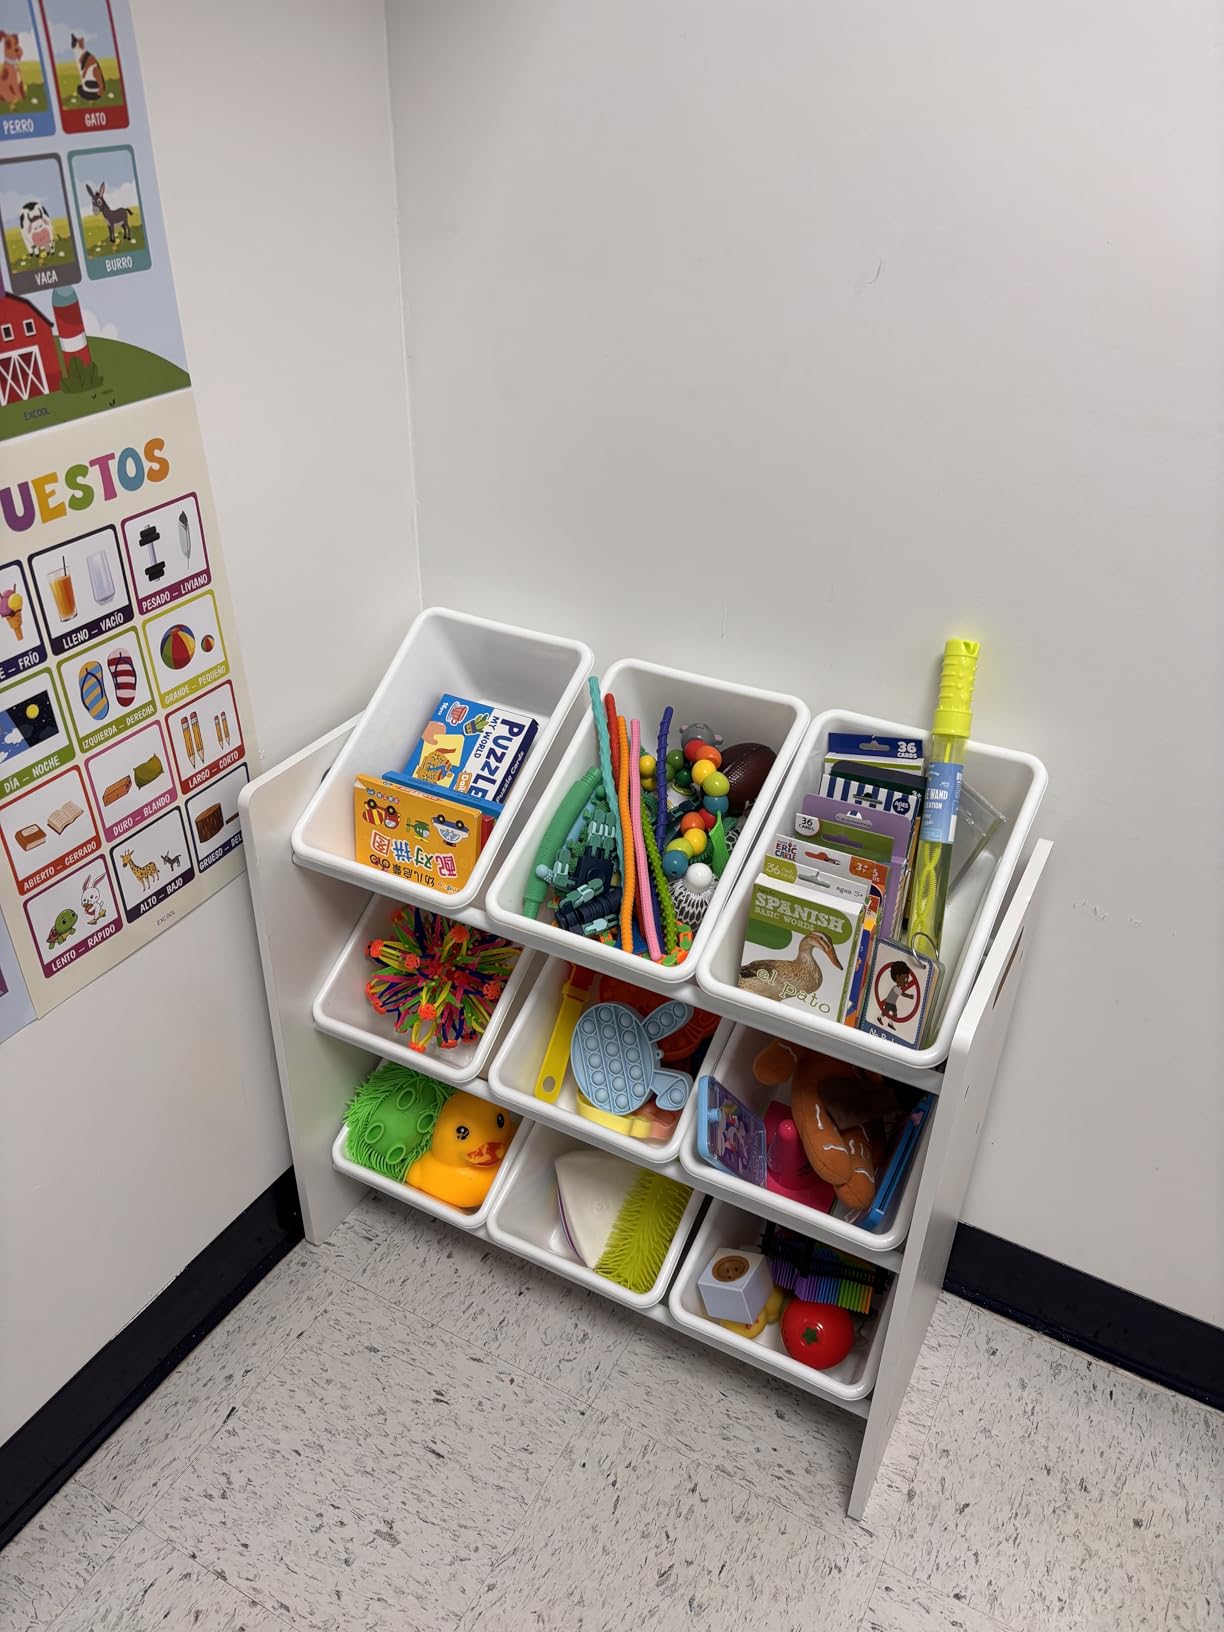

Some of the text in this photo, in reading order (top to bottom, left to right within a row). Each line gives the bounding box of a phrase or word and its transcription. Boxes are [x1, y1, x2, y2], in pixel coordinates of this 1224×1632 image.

[3, 118, 34, 135] PERRO
[84, 112, 106, 127] GATO
[105, 256, 133, 272] BURRO
[35, 270, 58, 286] VACA
[0, 437, 170, 532] UESTOS
[141, 591, 171, 612] PESADO
[180, 573, 209, 594] LIVIANO
[62, 629, 89, 649] LLENO
[100, 611, 125, 633] VACÍO
[18, 651, 40, 671] FRÍO
[164, 685, 191, 705] GRANDE
[198, 665, 227, 687] PEQUEÑO
[82, 725, 119, 749] IZQUIERDA
[126, 704, 155, 727] DERECHA
[473, 715, 501, 759] MY WORLD
[471, 718, 527, 801] PUZZLE
[896, 750, 918, 760] CARDS
[897, 741, 917, 755] 36
[188, 769, 211, 789] LARGO
[218, 750, 240, 769] CORTO
[510, 750, 525, 775] Cards
[3, 774, 20, 794] DÍA
[32, 757, 61, 777] NOCHE
[894, 801, 909, 809] AGES
[930, 788, 948, 800] WAND
[112, 817, 134, 837] DURO
[143, 794, 171, 817] BLANDO
[798, 823, 815, 832] CARDS
[801, 817, 813, 827] 36
[199, 848, 224, 871] GRUESO
[371, 830, 457, 877] 配对拼图
[775, 842, 798, 855] ERIC
[23, 866, 56, 891] ABIERTO
[64, 841, 97, 866] CERRADO
[766, 862, 780, 875] 36
[139, 895, 158, 914] ALTO
[166, 877, 184, 895] BAJO
[835, 885, 853, 895] ages
[754, 891, 846, 934] SPANISH
[754, 906, 815, 931] BASIC WORDS
[51, 949, 77, 972] LENTO
[87, 923, 116, 948] RÁPIDO
[756, 968, 832, 1015] el pato
